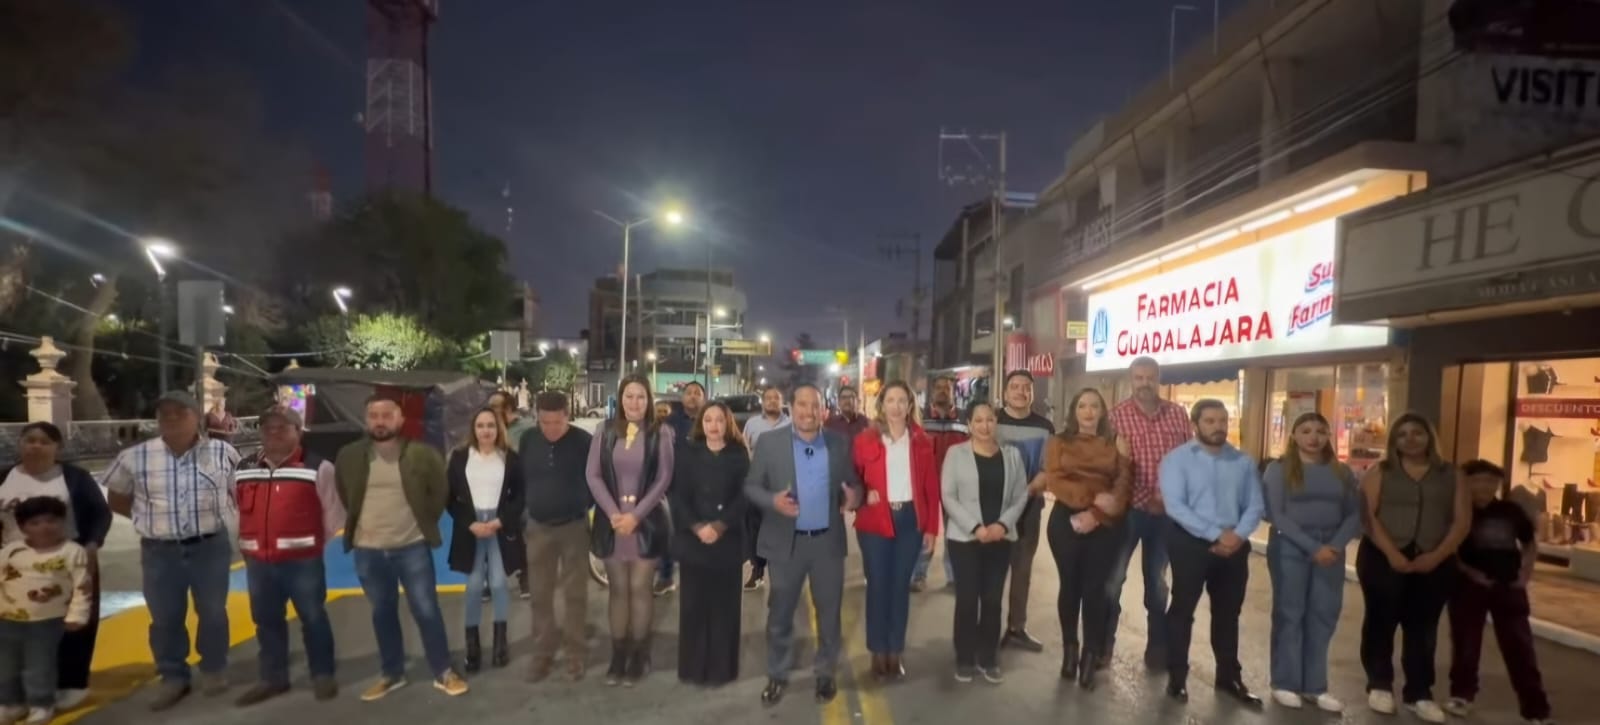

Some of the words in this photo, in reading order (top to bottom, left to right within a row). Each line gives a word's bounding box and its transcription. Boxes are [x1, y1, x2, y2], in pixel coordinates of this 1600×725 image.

[1491, 64, 1600, 107] VISIT
[1416, 193, 1520, 271] HE
[1137, 276, 1240, 321] FARMACIA
[1117, 311, 1273, 356] GUADALAJARA
